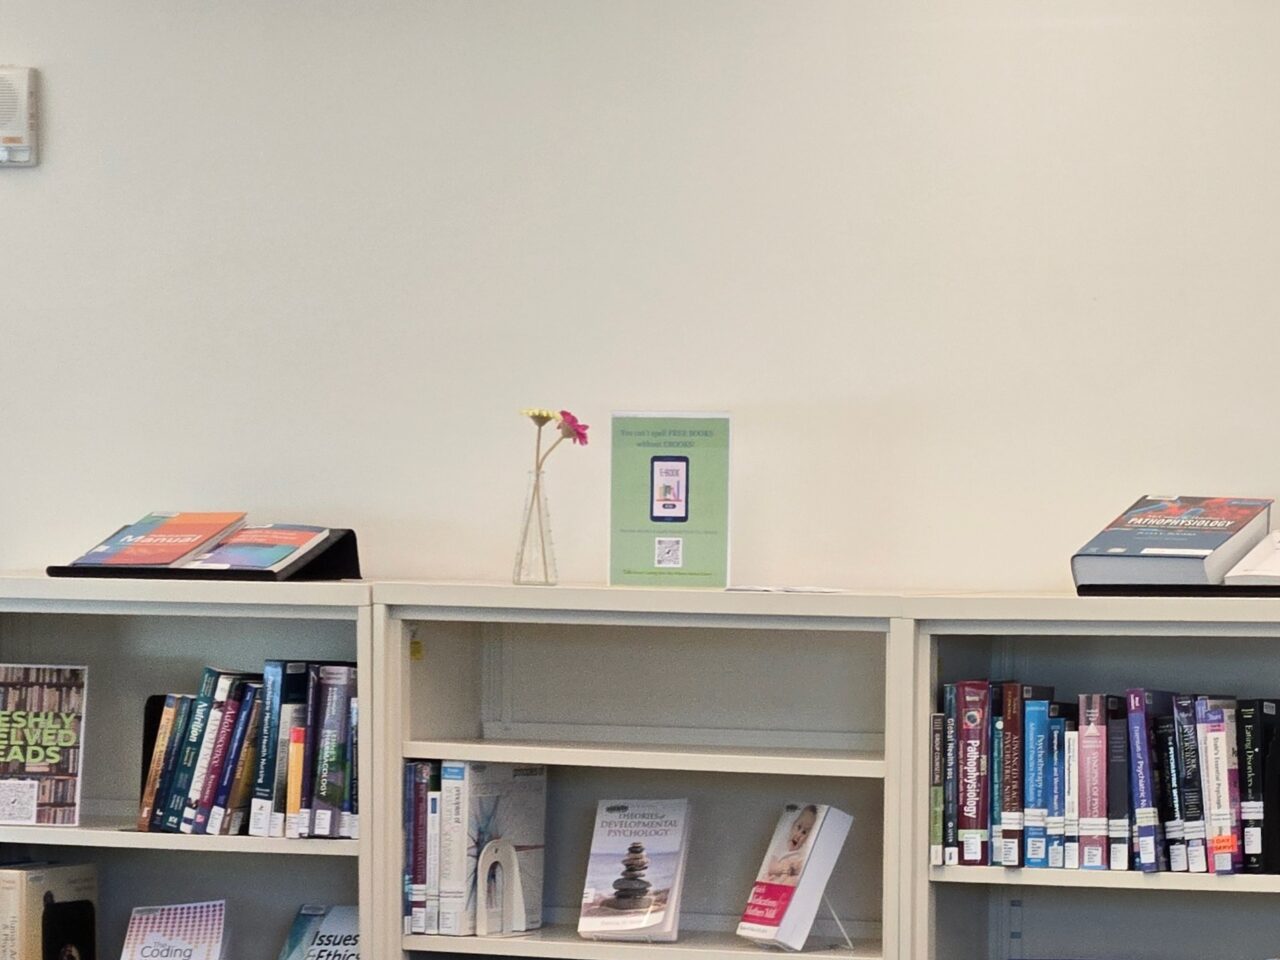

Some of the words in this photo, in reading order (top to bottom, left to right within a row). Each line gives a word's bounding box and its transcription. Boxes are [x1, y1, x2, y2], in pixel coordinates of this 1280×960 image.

[1127, 517, 1235, 529] PATHOPHYSIOLOGY
[120, 534, 201, 546] Manual
[188, 701, 208, 742] Nutrition
[262, 712, 270, 735] Mental
[946, 718, 954, 741] Global
[213, 705, 236, 768] Adolescence
[261, 736, 269, 757] Health
[1244, 725, 1254, 749] Eating
[946, 743, 954, 766] Health
[1033, 734, 1044, 788] Psychotherapy
[257, 758, 267, 784] Nursing
[964, 740, 980, 818] Pathophysiology
[1137, 760, 1145, 798] Psychiatric
[1246, 750, 1255, 787] Disorders
[600, 820, 678, 829] DEVELOPMENTAL
[607, 829, 671, 837] PSYCHOLOGY
[311, 931, 360, 947] Issues
